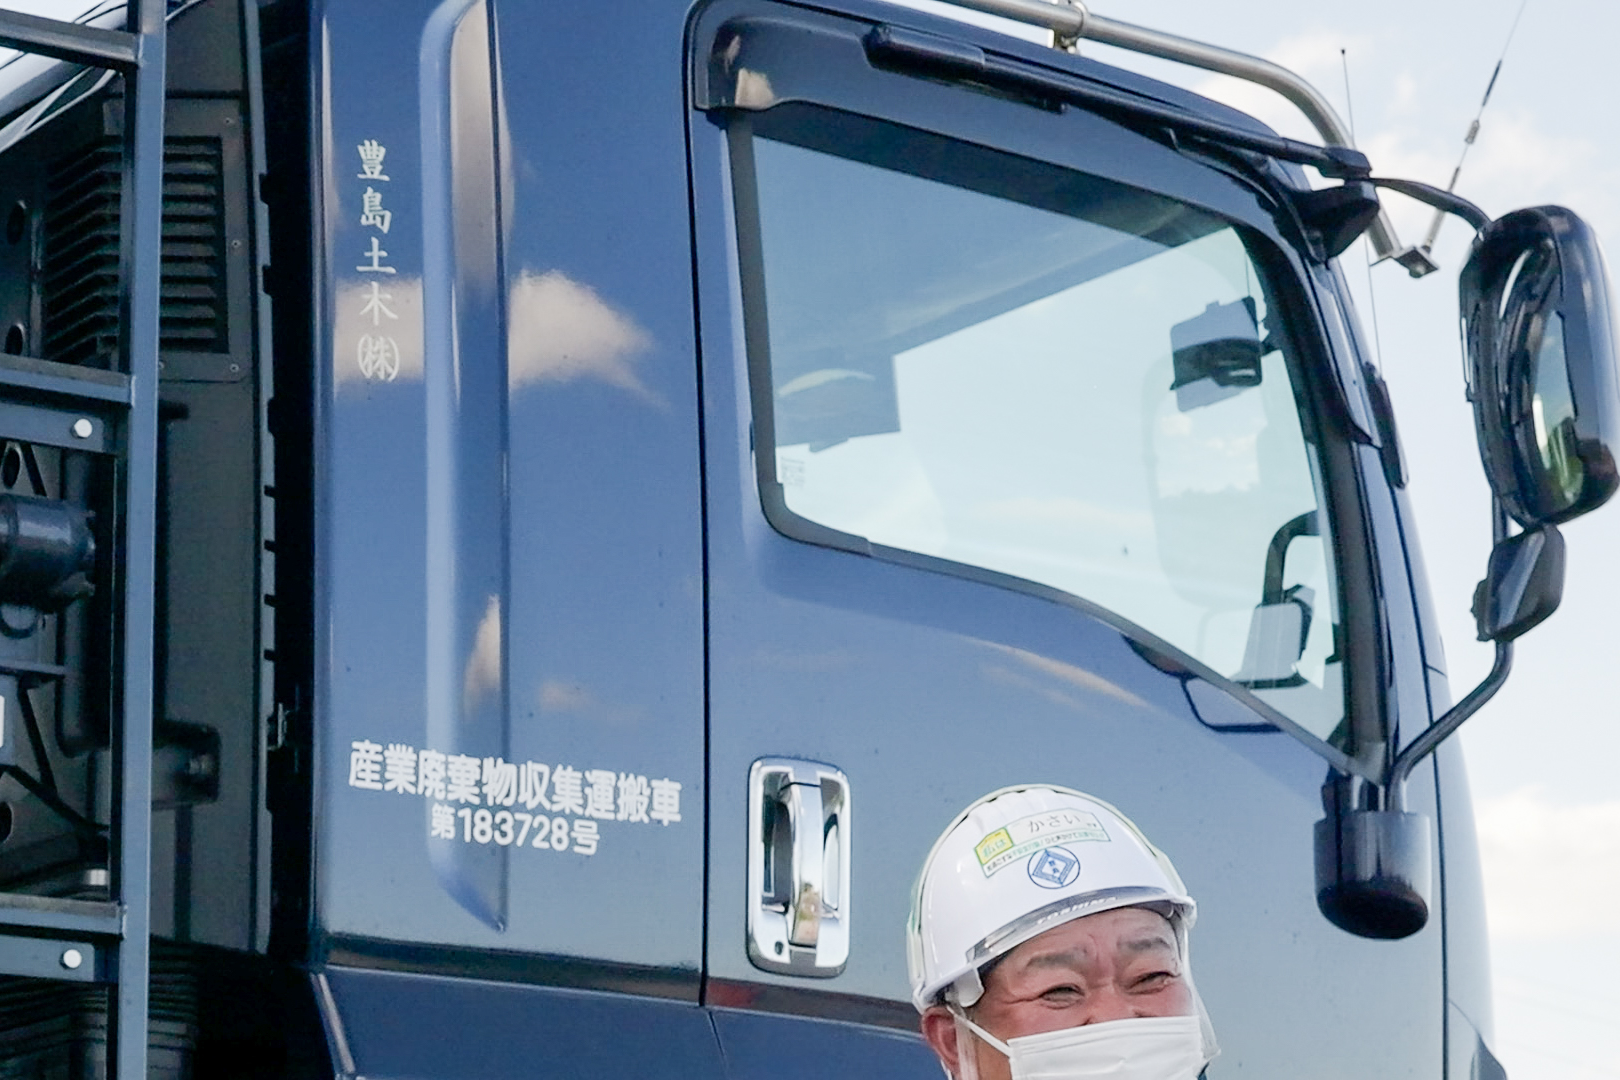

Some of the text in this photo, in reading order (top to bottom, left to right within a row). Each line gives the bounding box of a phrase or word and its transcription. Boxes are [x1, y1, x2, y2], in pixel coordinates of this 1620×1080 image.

[348, 739, 682, 826] 産業廃棄物収集運搬車
[430, 803, 600, 856] 第183728号
[1028, 814, 1081, 833] かさい
